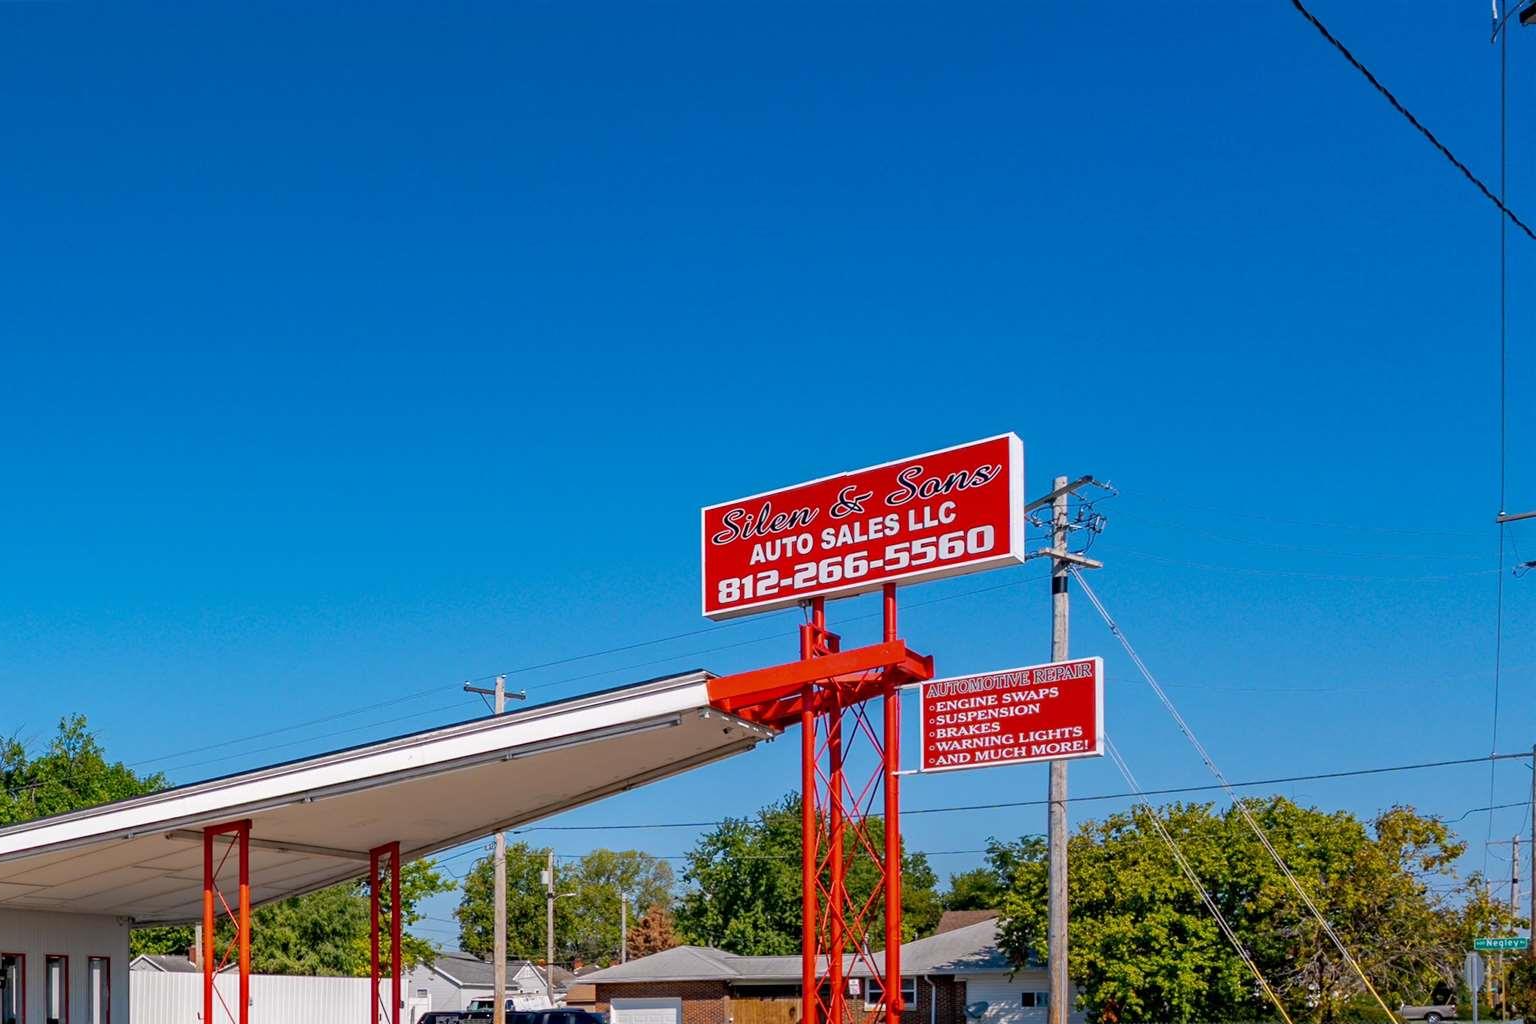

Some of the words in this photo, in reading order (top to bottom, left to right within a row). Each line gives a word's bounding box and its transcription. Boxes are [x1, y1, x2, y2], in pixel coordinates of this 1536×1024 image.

[712, 501, 819, 545] Silen
[829, 485, 873, 519] &
[885, 464, 1002, 507] Sons
[750, 533, 814, 566] AUTO
[821, 513, 900, 550] SALES
[908, 501, 957, 531] LLC
[718, 525, 995, 604] 812-266-5560
[927, 671, 1030, 699] AUTOMOTIVE
[1033, 663, 1093, 685] REPAIR
[936, 694, 998, 713] ENGINE
[1002, 687, 1060, 702] SWAPS
[936, 703, 1041, 726] SUSPENSION
[936, 721, 1001, 740] BRAKES
[936, 734, 1014, 752] WARNING
[1019, 725, 1083, 744] LIGHTS
[936, 753, 971, 766] AND
[975, 746, 1026, 762] MUCH
[1031, 739, 1089, 756] MORE!
